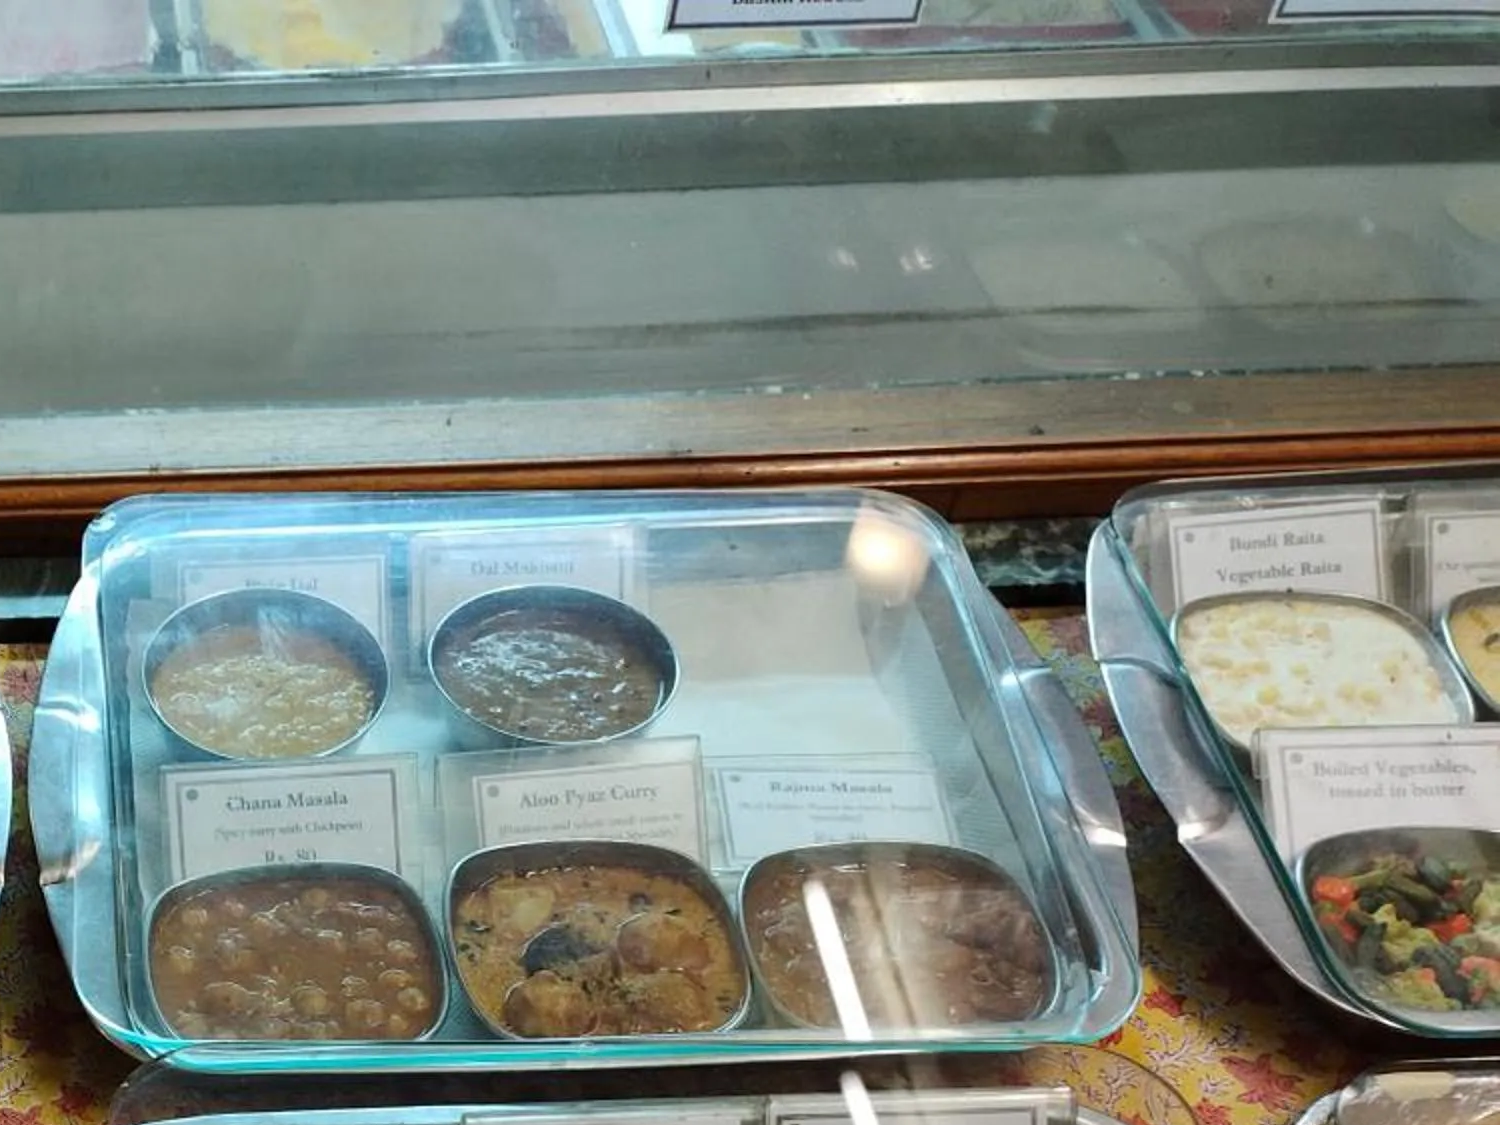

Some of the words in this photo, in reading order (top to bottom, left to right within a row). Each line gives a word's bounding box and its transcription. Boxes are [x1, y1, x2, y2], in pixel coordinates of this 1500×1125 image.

[1283, 531, 1325, 546] Raita
[1216, 566, 1295, 584] Vegetable
[1300, 561, 1342, 577] Raita
[1313, 761, 1369, 777] Boiled
[520, 792, 559, 809] Aloo
[610, 785, 659, 803] Curry
[1389, 784, 1407, 798] in
[226, 795, 282, 812] Chana
[286, 791, 349, 808] Masala
